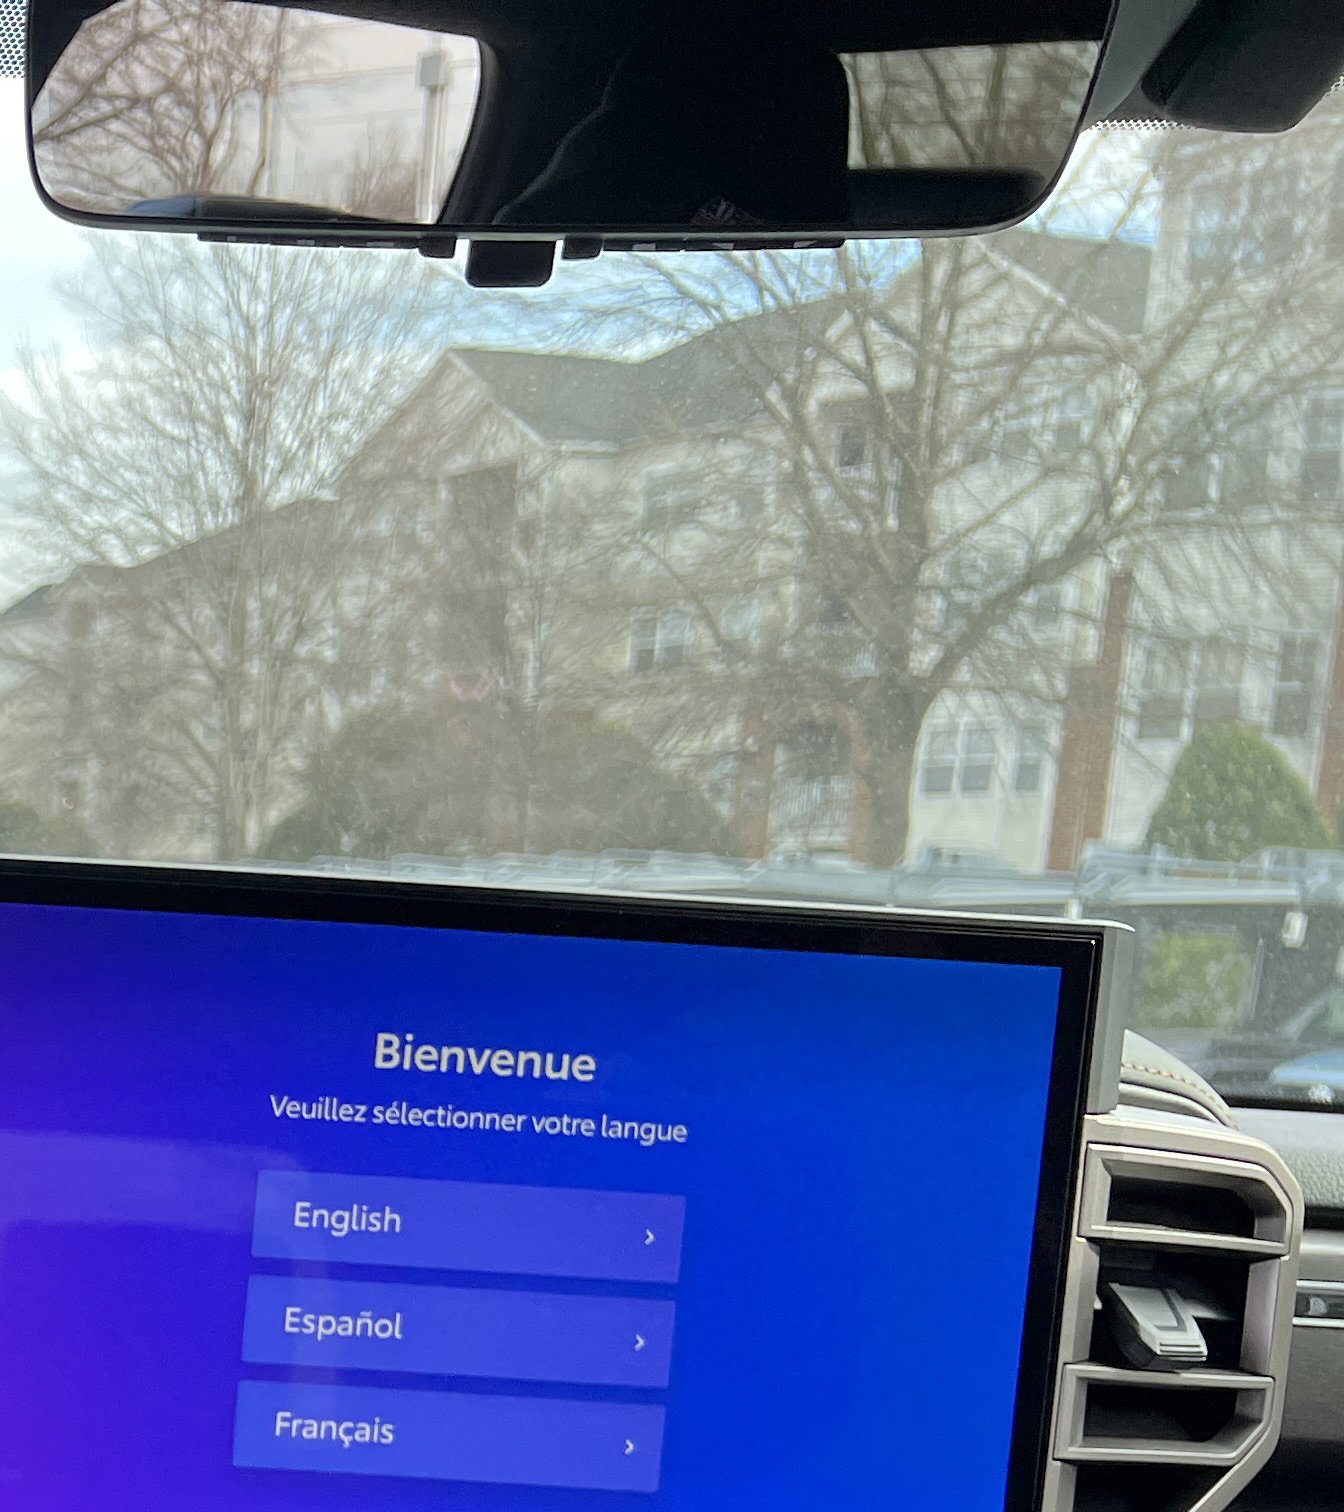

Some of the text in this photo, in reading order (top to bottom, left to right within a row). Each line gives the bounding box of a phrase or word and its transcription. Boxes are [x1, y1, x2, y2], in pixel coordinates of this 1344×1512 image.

[373, 1032, 597, 1082] Bienvenue
[269, 1094, 688, 1147] Veuillez sélectionner votre langue
[293, 1201, 403, 1238] English
[283, 1306, 403, 1341] Español
[274, 1411, 396, 1449] Français
